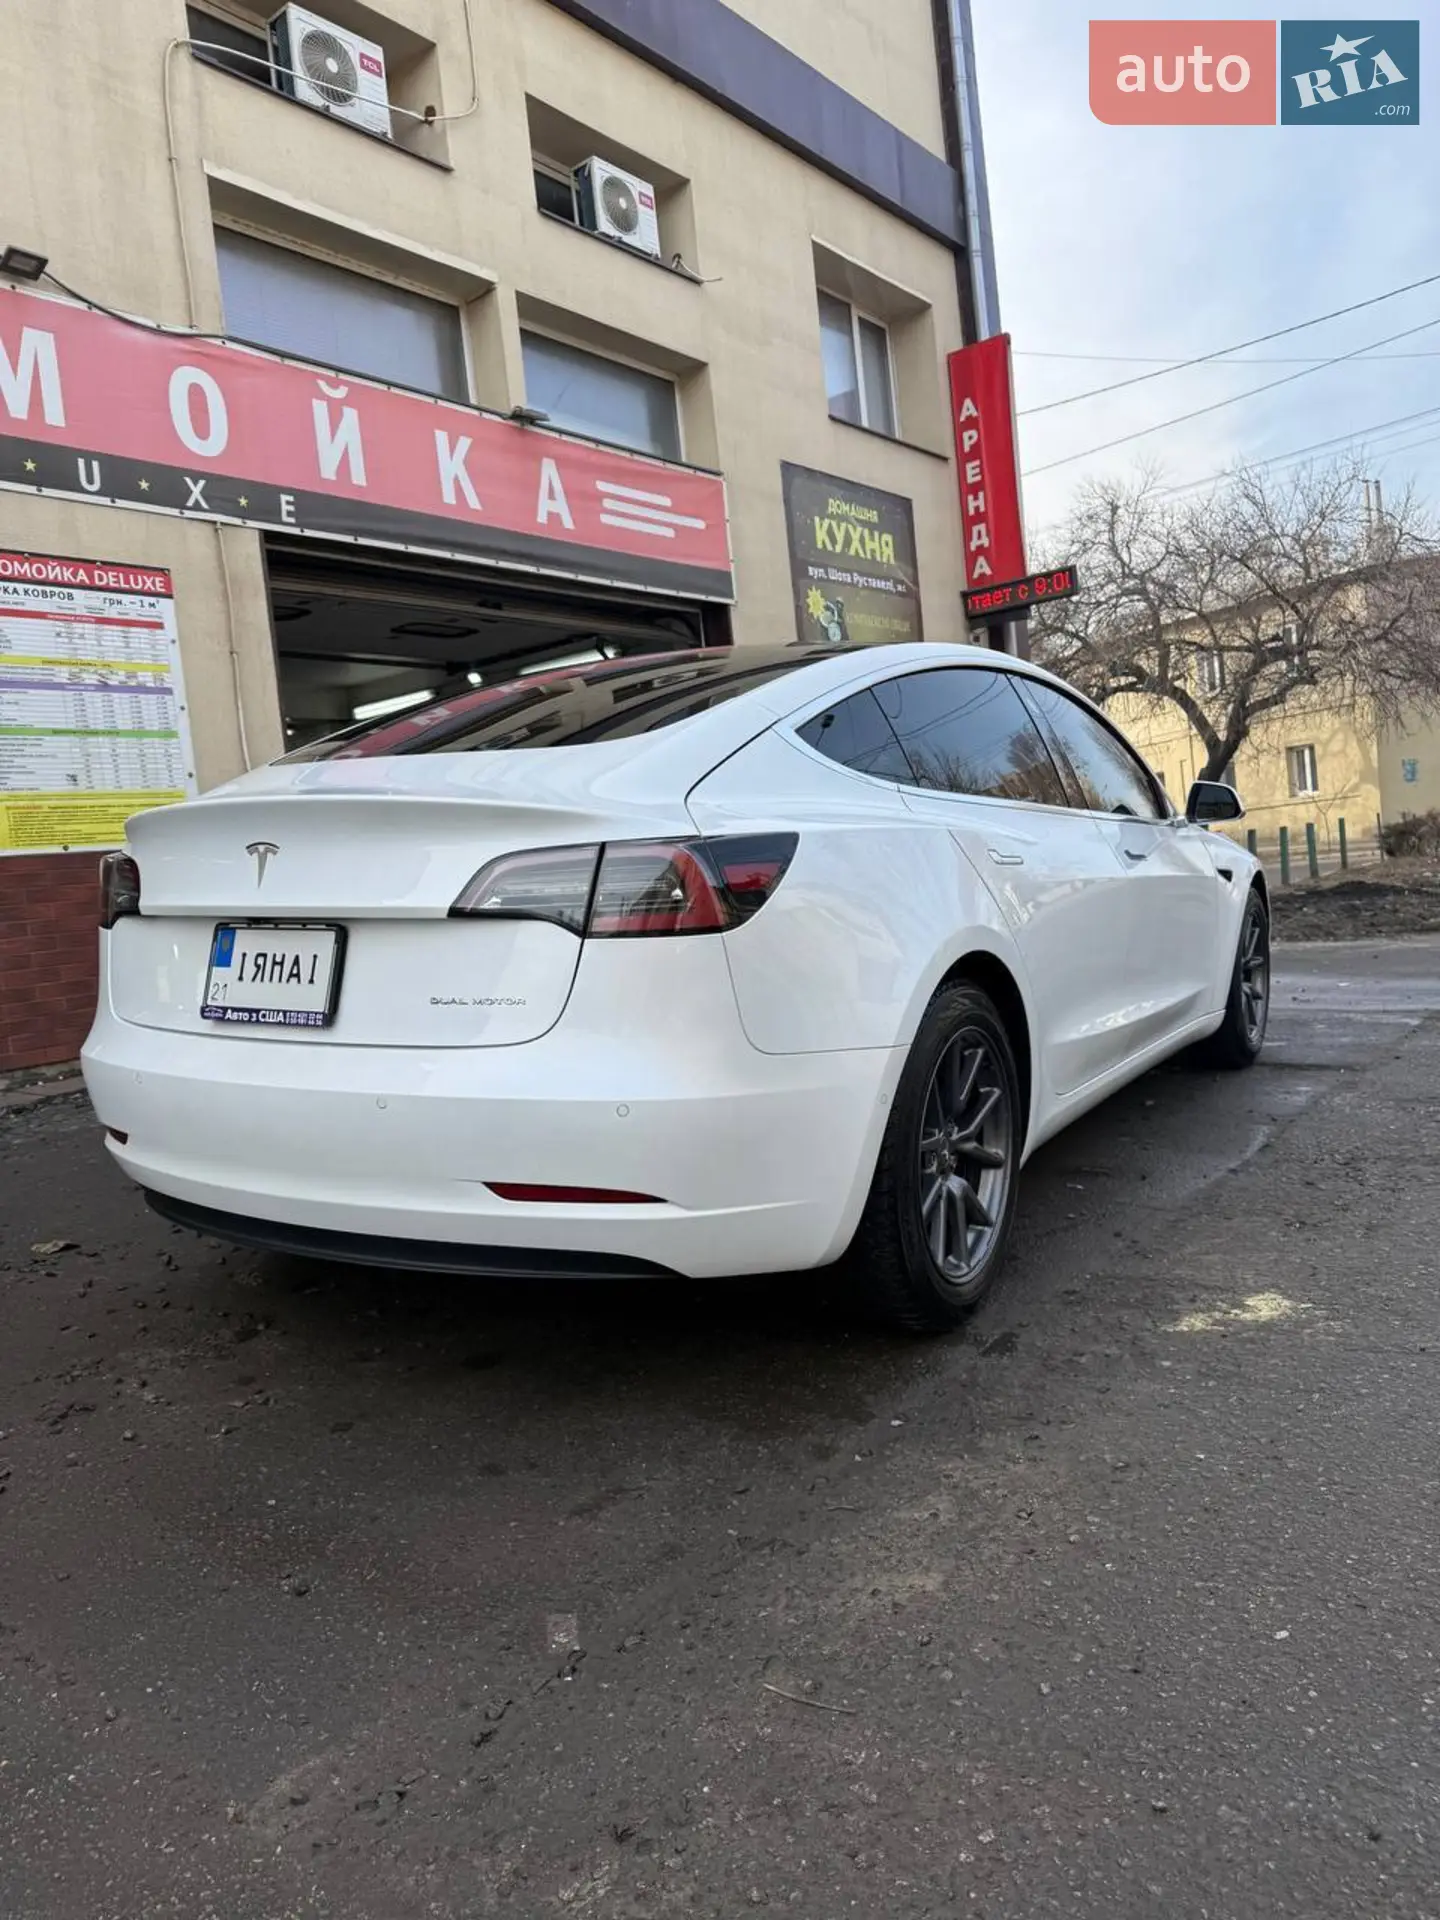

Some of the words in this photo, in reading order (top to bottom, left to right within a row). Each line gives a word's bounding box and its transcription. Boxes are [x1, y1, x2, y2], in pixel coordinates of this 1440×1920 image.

[959, 397, 992, 580] АРЕНДА
[828, 498, 879, 523] ДОМАШНЯ
[814, 516, 895, 565] КУХНЯ
[94, 569, 166, 592] DELUXE
[23, 587, 75, 601] КОВРОВ
[211, 982, 228, 1002] 21
[430, 997, 468, 1006] DUAL
[472, 998, 526, 1006] MOTOR
[225, 1008, 250, 1021] Авто
[259, 1010, 285, 1023] США
